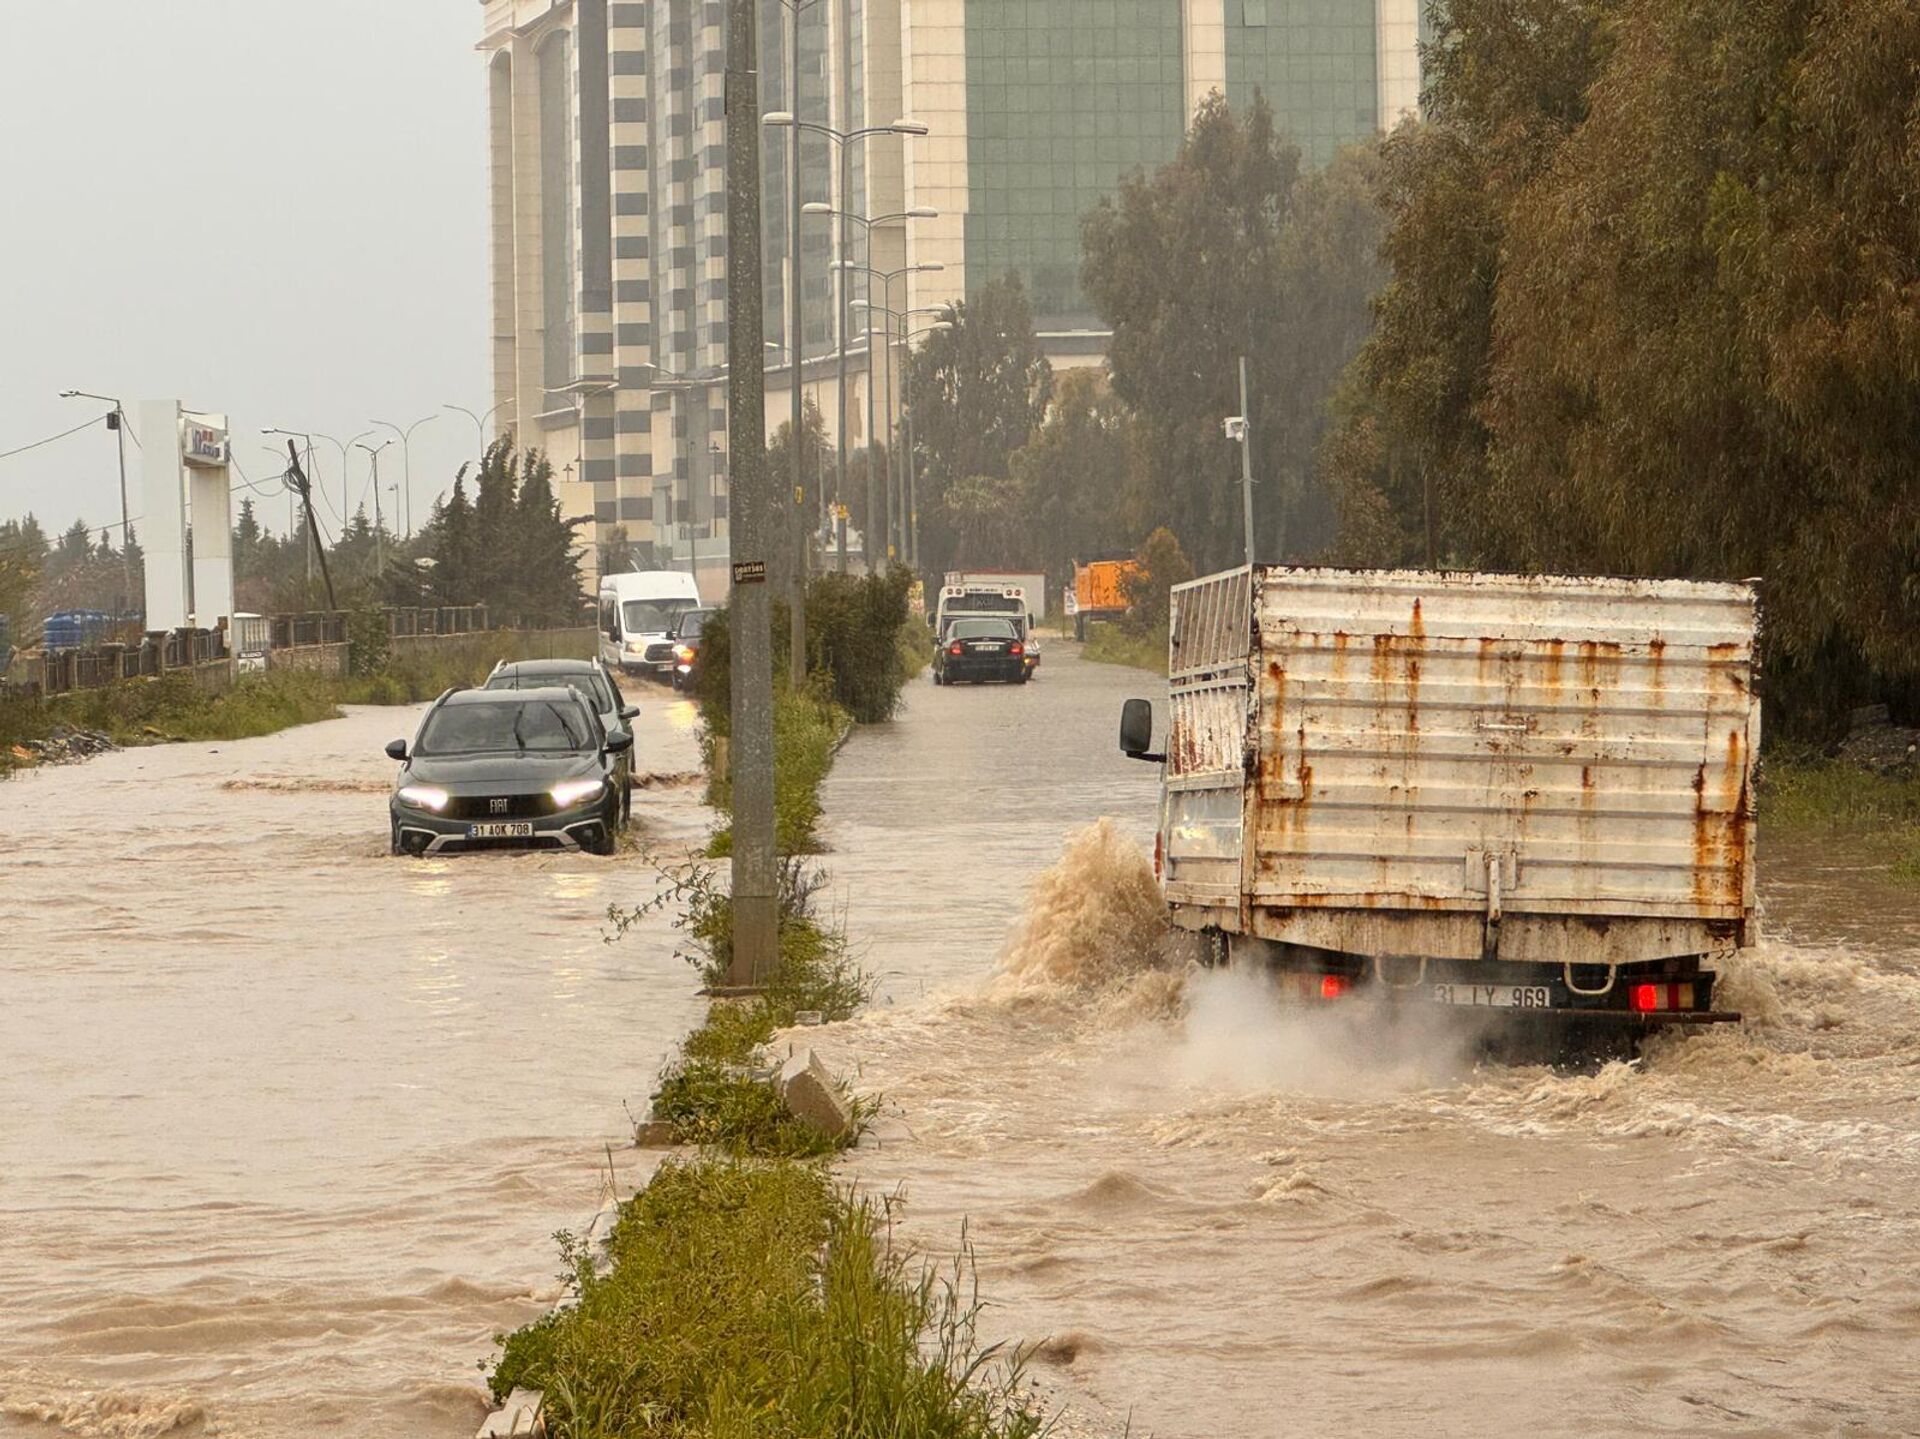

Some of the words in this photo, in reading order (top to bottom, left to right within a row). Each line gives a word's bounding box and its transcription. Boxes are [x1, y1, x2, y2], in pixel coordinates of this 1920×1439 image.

[490, 798, 508, 813] FIAT
[472, 825, 484, 837] 31
[511, 824, 529, 836] 708
[1434, 984, 1455, 1004] 31
[1512, 987, 1546, 1009] 969
